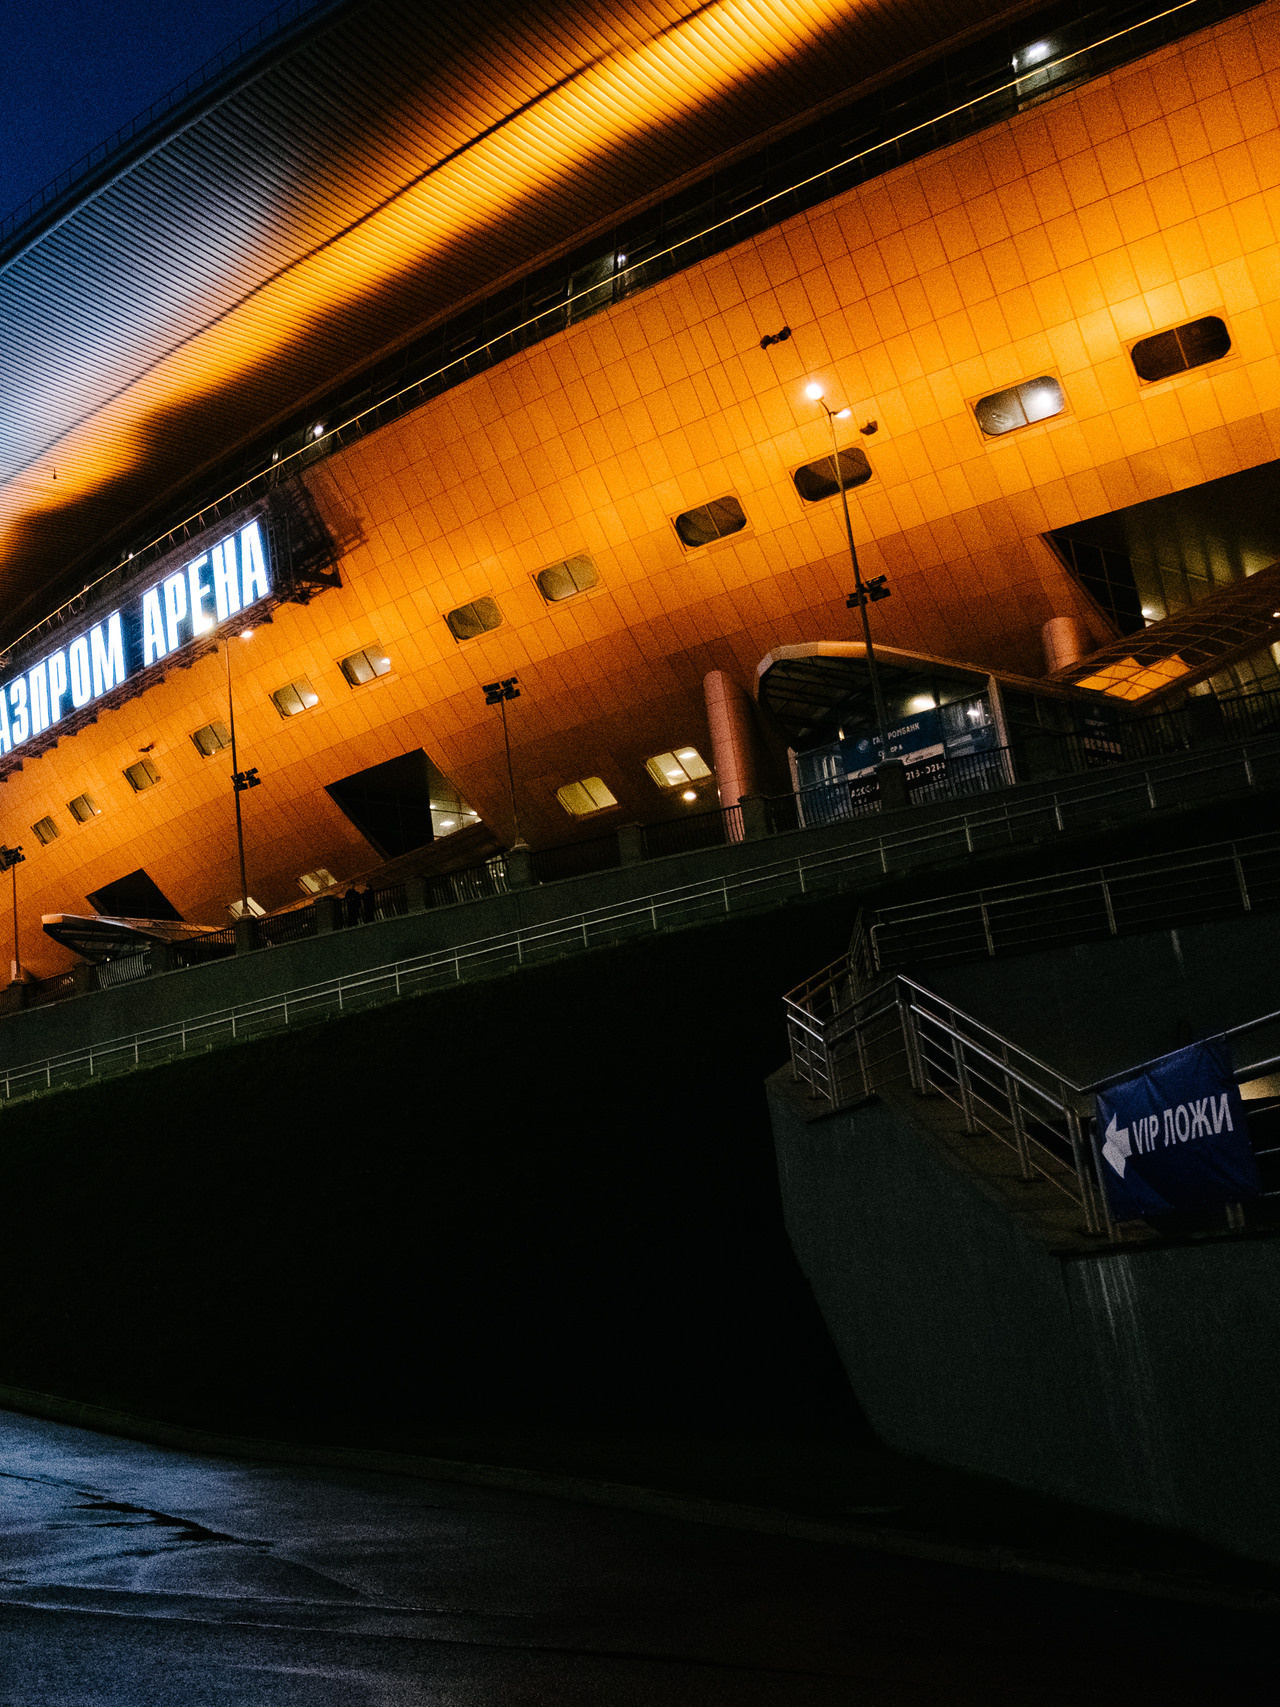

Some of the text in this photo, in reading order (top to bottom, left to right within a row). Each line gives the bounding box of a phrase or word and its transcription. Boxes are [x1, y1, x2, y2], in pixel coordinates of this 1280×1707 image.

[142, 521, 270, 668] АРЕНА
[872, 722, 921, 745] ГАРОМБАНК
[1132, 1093, 1234, 1155] VIP ЛОЖИ
